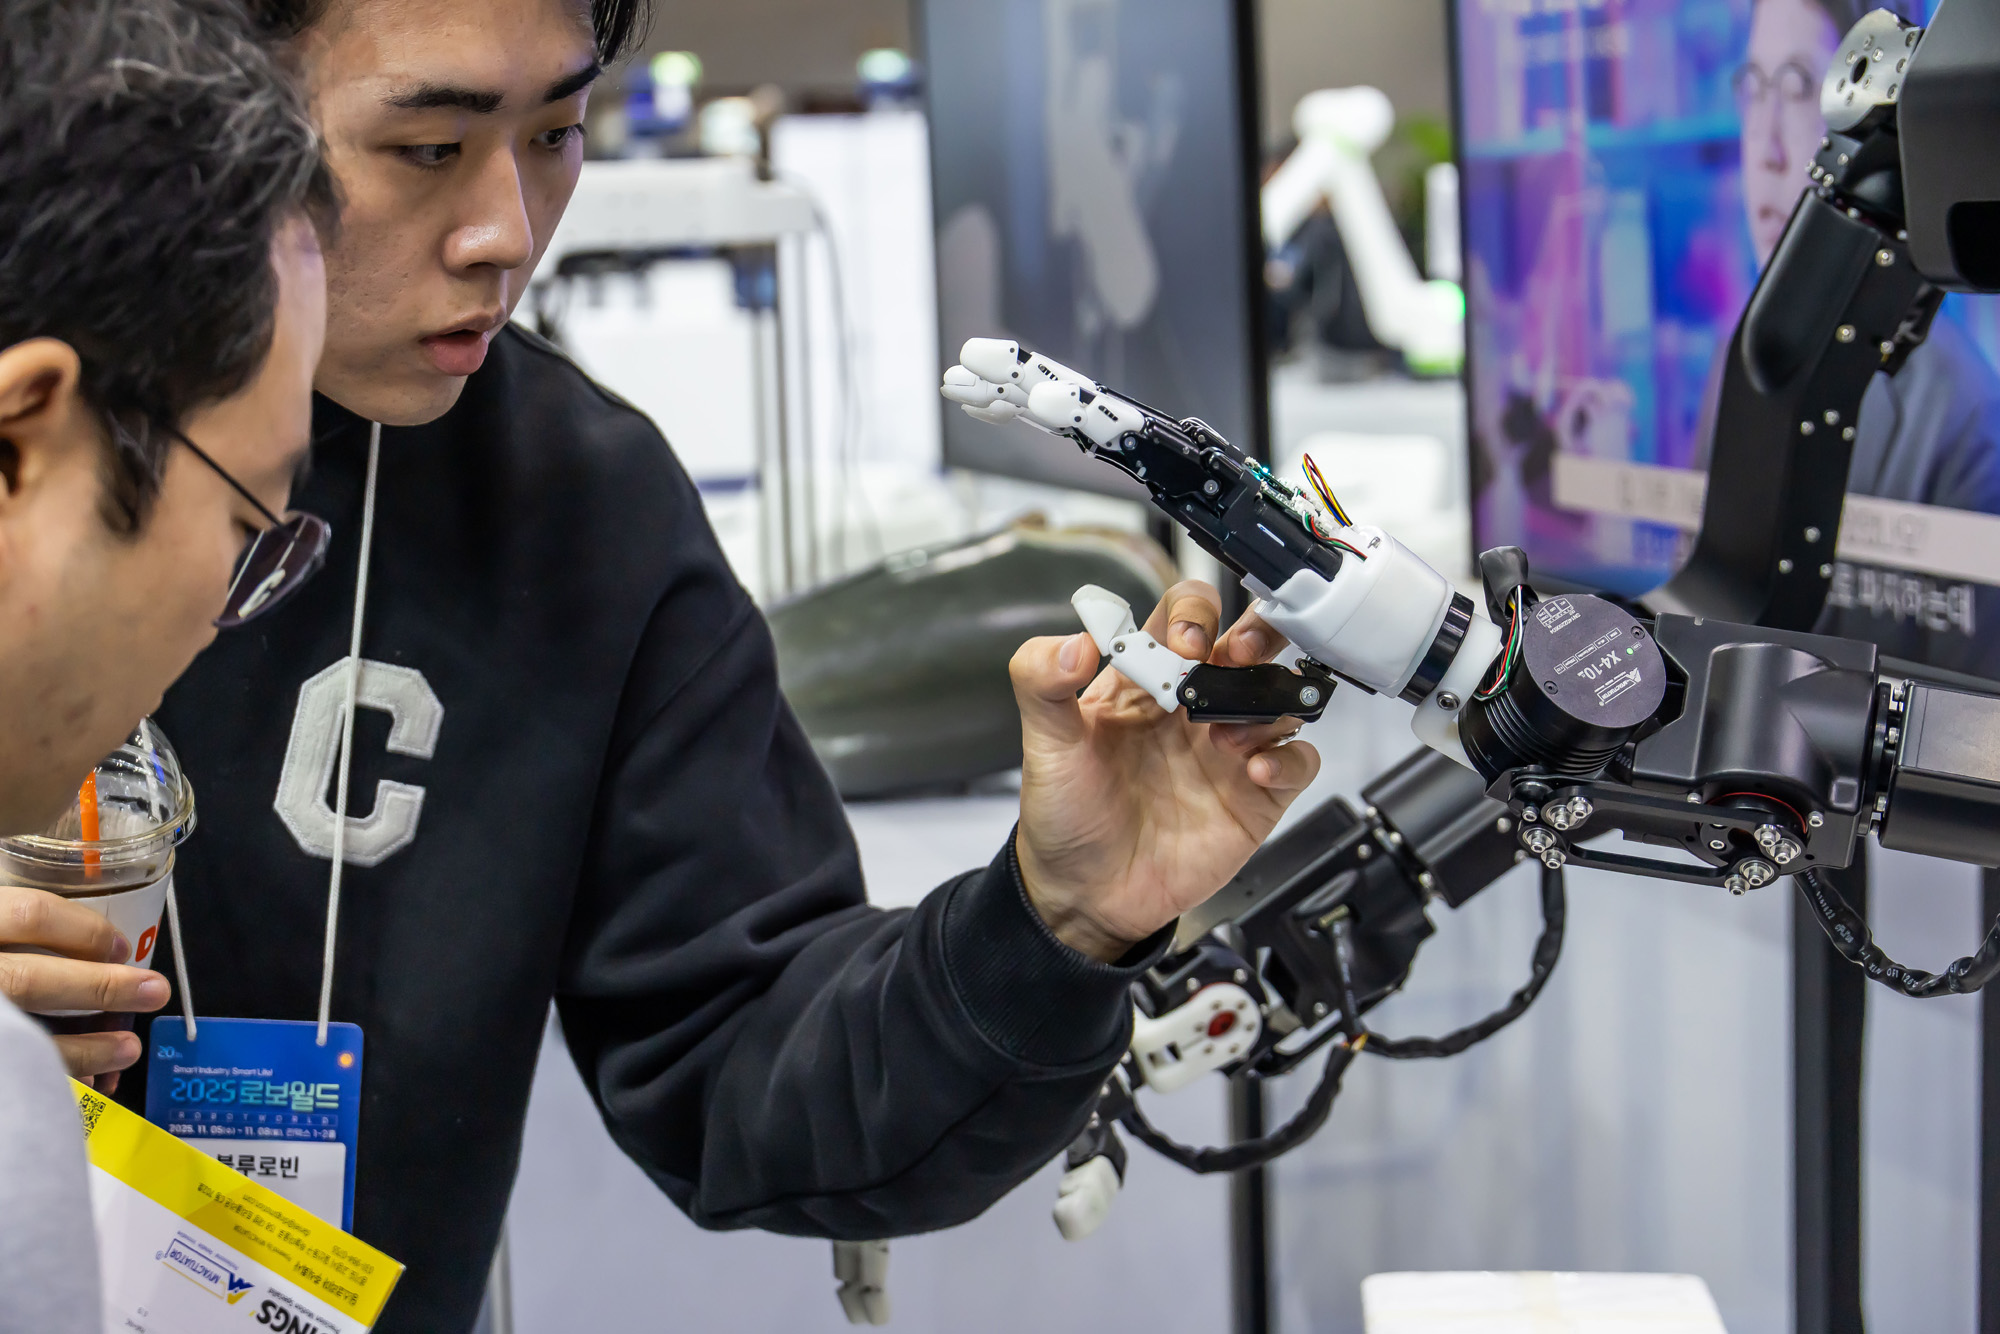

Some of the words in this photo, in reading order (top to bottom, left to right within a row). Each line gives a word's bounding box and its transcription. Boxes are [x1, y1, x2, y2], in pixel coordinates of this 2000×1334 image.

[274, 656, 445, 868] C
[173, 1064, 198, 1074] Smart
[231, 1066, 256, 1076] Smart
[171, 1078, 236, 1104] 2025
[239, 1080, 340, 1112] 로보월드
[169, 1248, 221, 1284] MYACTUATOR
